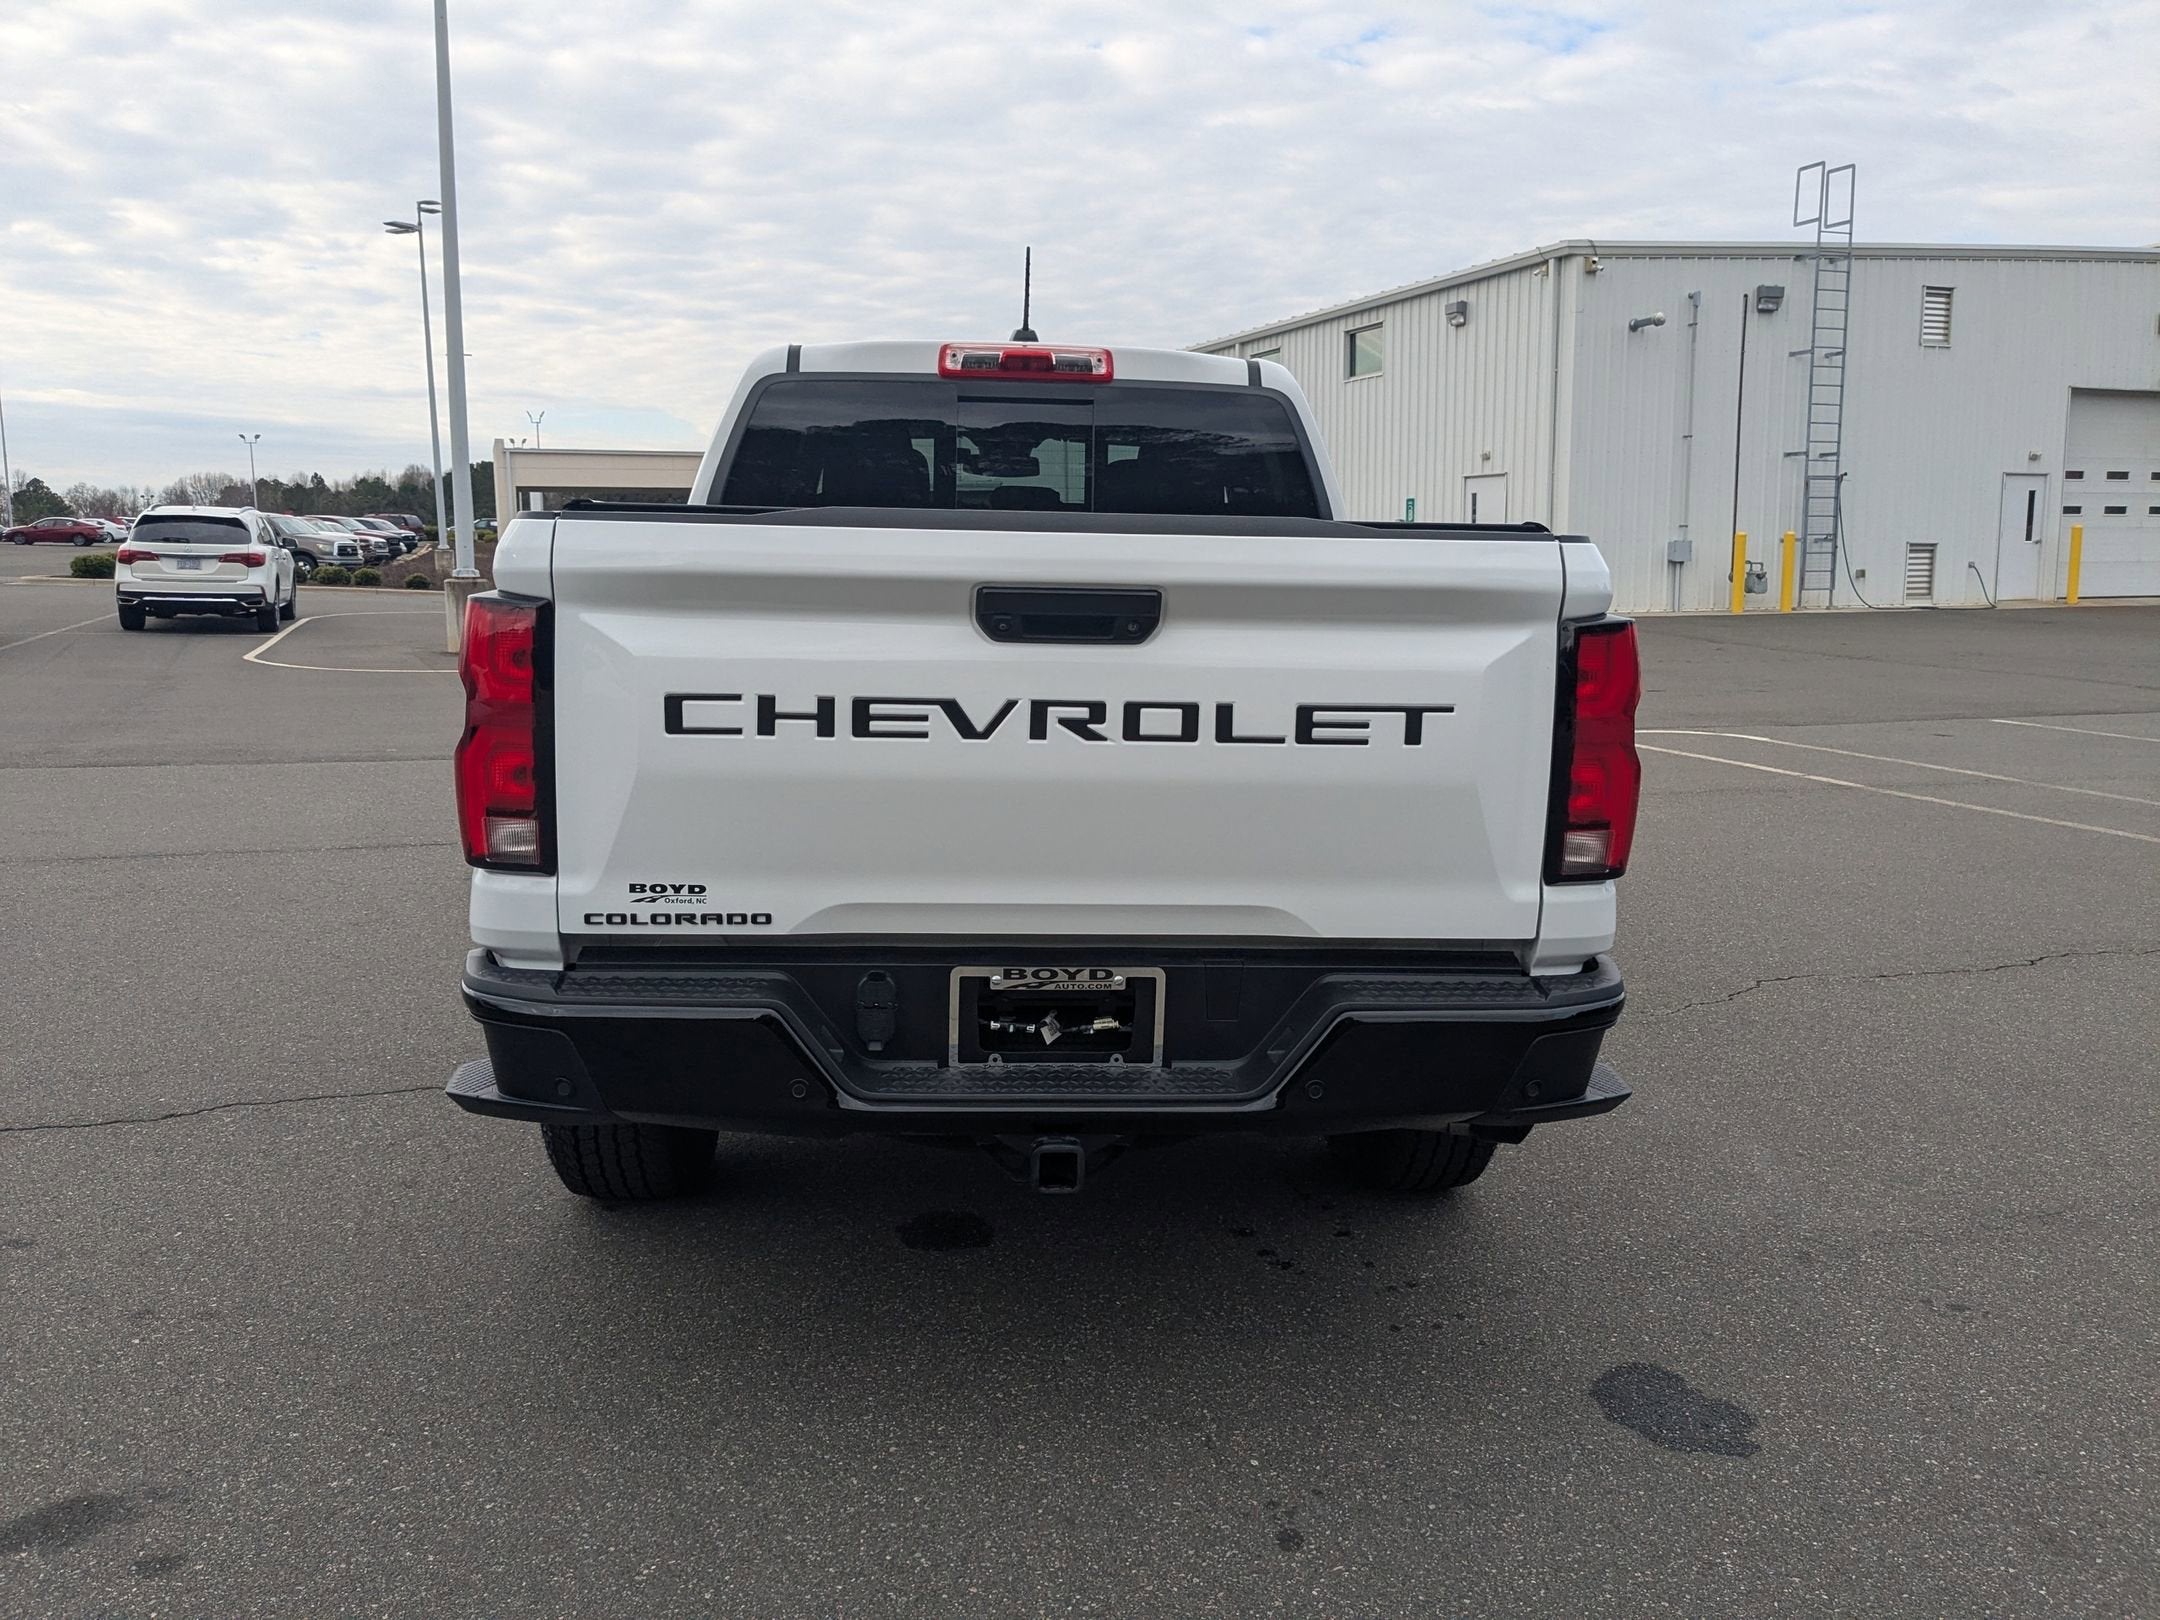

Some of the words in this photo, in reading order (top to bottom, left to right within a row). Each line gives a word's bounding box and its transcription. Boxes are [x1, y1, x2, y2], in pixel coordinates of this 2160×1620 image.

[664, 692, 1455, 746] CHEVROLET
[628, 883, 707, 895] BOYD
[664, 897, 694, 905] Oxford,
[696, 897, 707, 905] NC
[583, 912, 773, 926] COLORADO
[1002, 968, 1114, 981] BOYD
